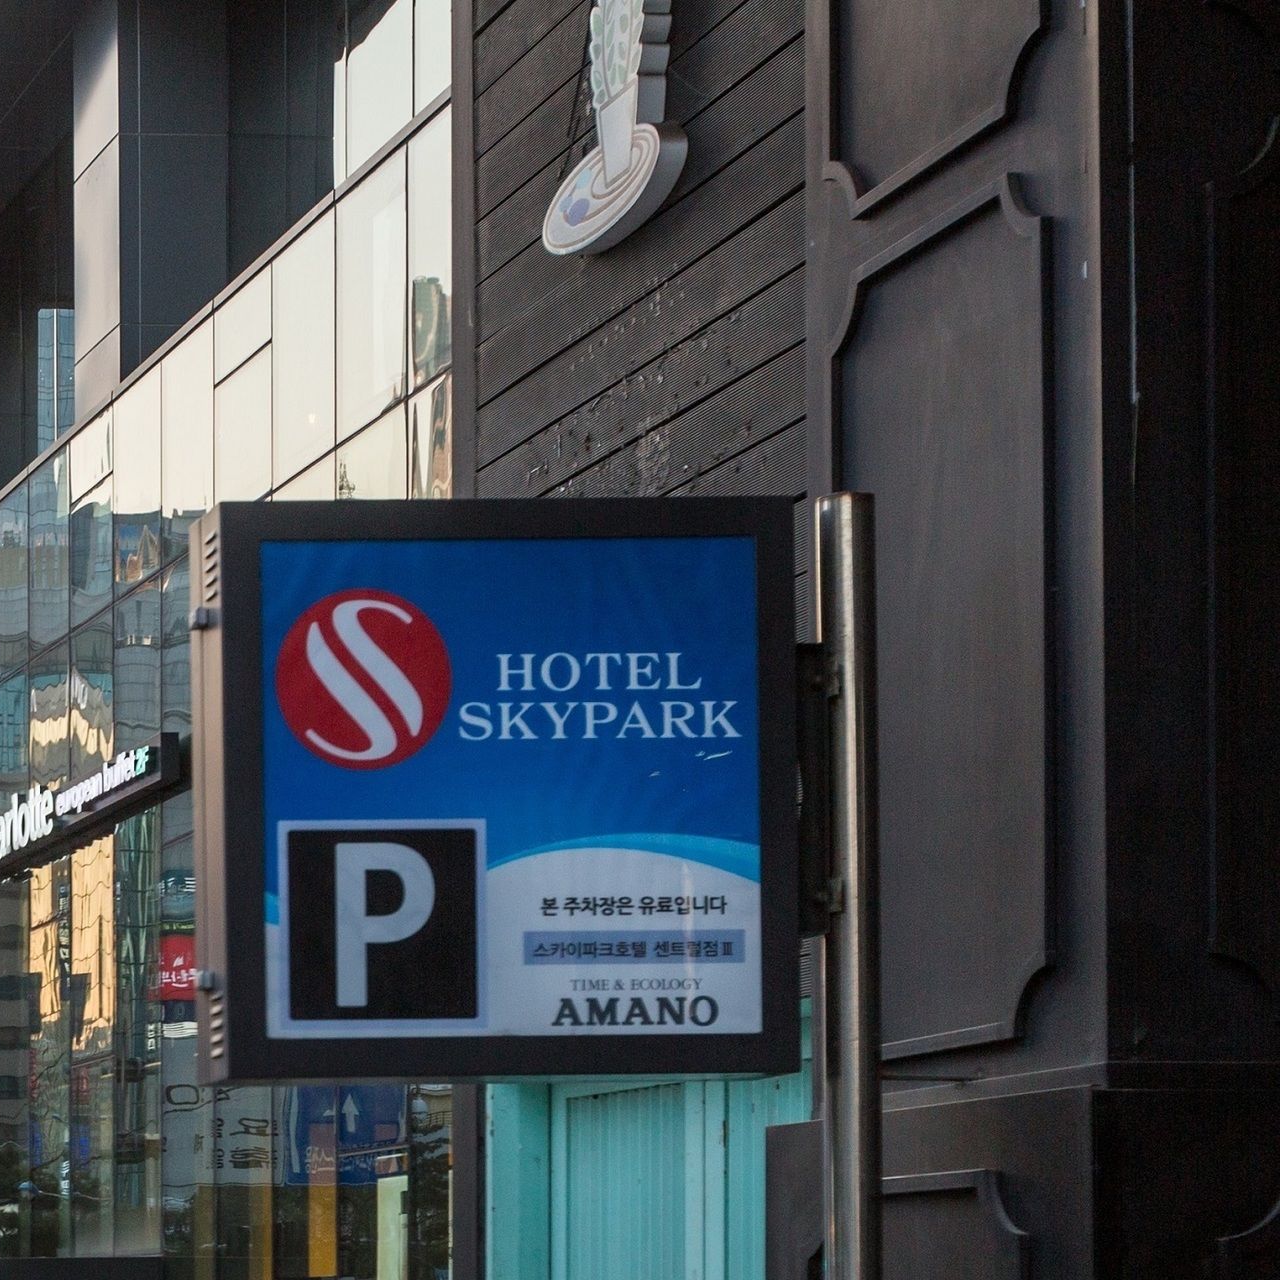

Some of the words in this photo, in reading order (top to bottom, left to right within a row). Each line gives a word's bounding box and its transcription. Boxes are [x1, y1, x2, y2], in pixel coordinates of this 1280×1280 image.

[496, 652, 702, 692] HOTEL
[458, 700, 742, 741] SKYPARK
[56, 772, 103, 817] european
[102, 750, 136, 793] buffet
[540, 897, 559, 916] 본
[563, 896, 634, 916] 주차장은
[638, 895, 728, 915] 유료입니다
[335, 841, 436, 1009] P
[533, 941, 648, 959] 스카이파크호텔
[570, 979, 610, 991] TIME
[614, 979, 625, 991] &
[630, 978, 703, 991] ECOLOGY
[551, 995, 719, 1026] AMANO
